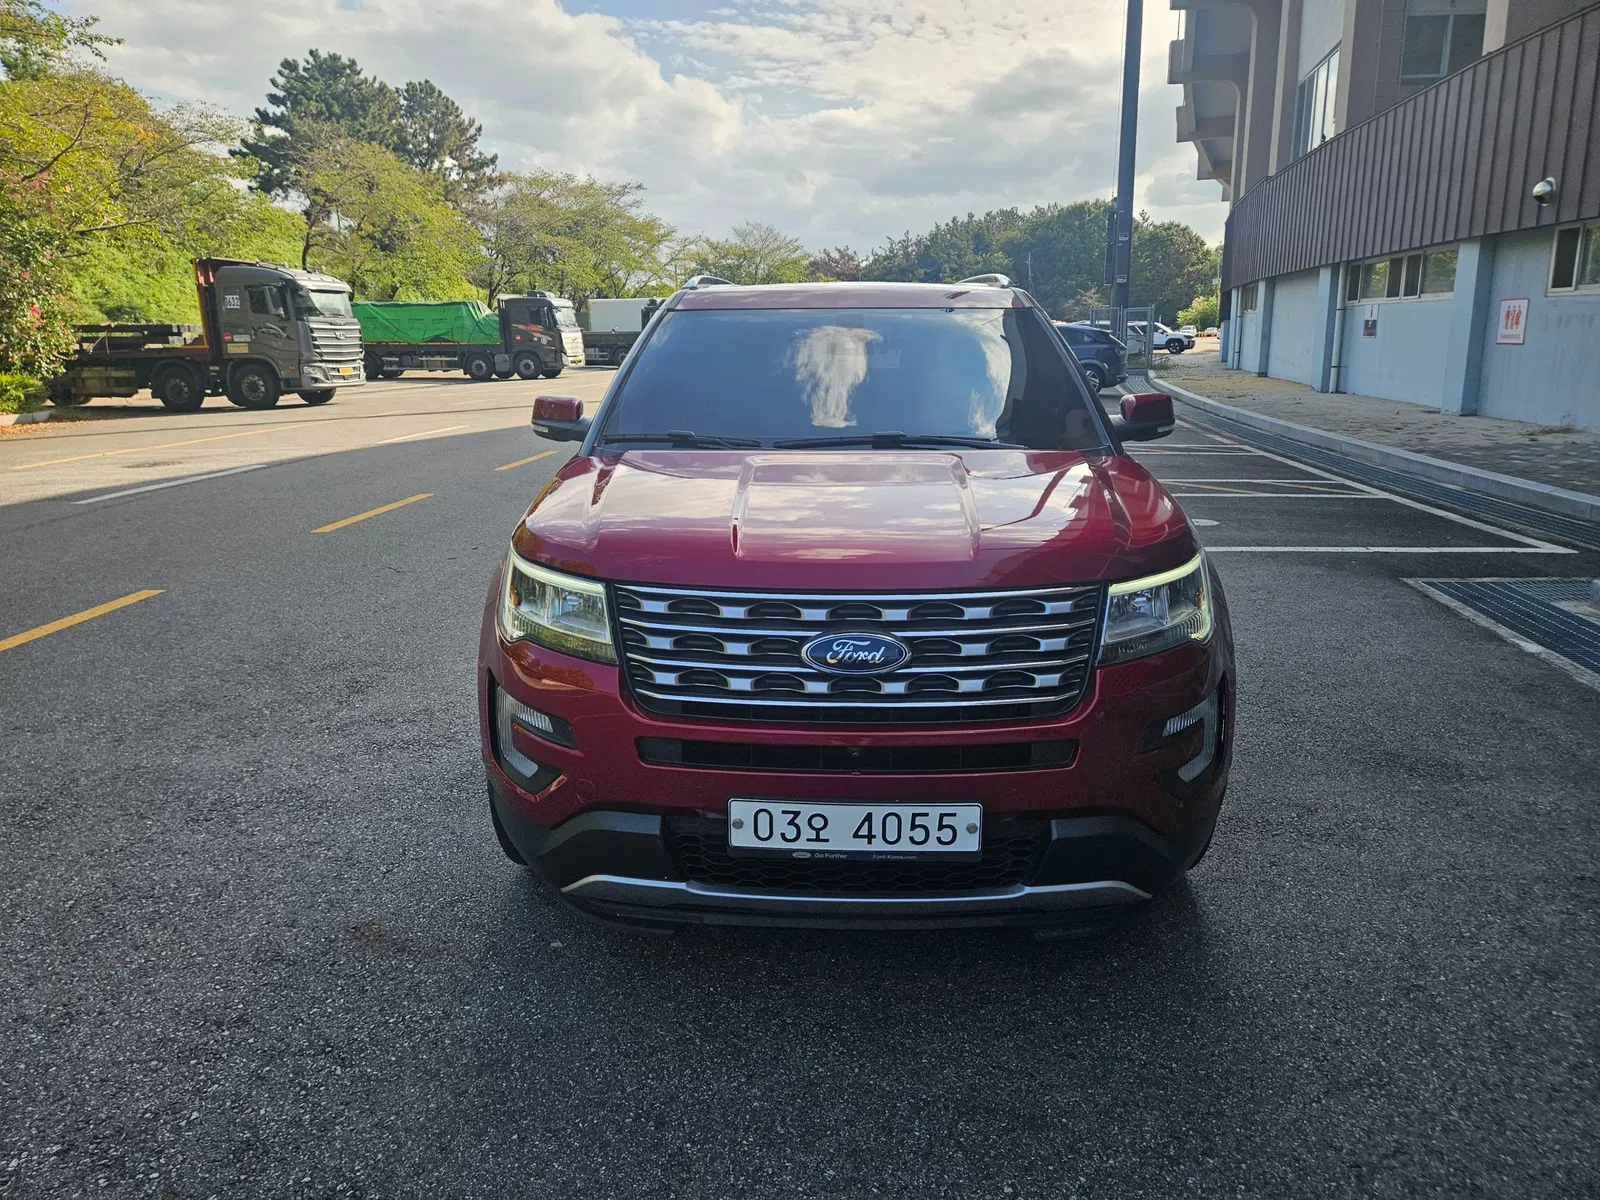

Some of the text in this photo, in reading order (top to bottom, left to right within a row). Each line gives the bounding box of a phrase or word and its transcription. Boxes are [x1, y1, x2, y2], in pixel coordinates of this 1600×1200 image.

[826, 639, 886, 664] Ford
[753, 808, 957, 846] 03오 4055
